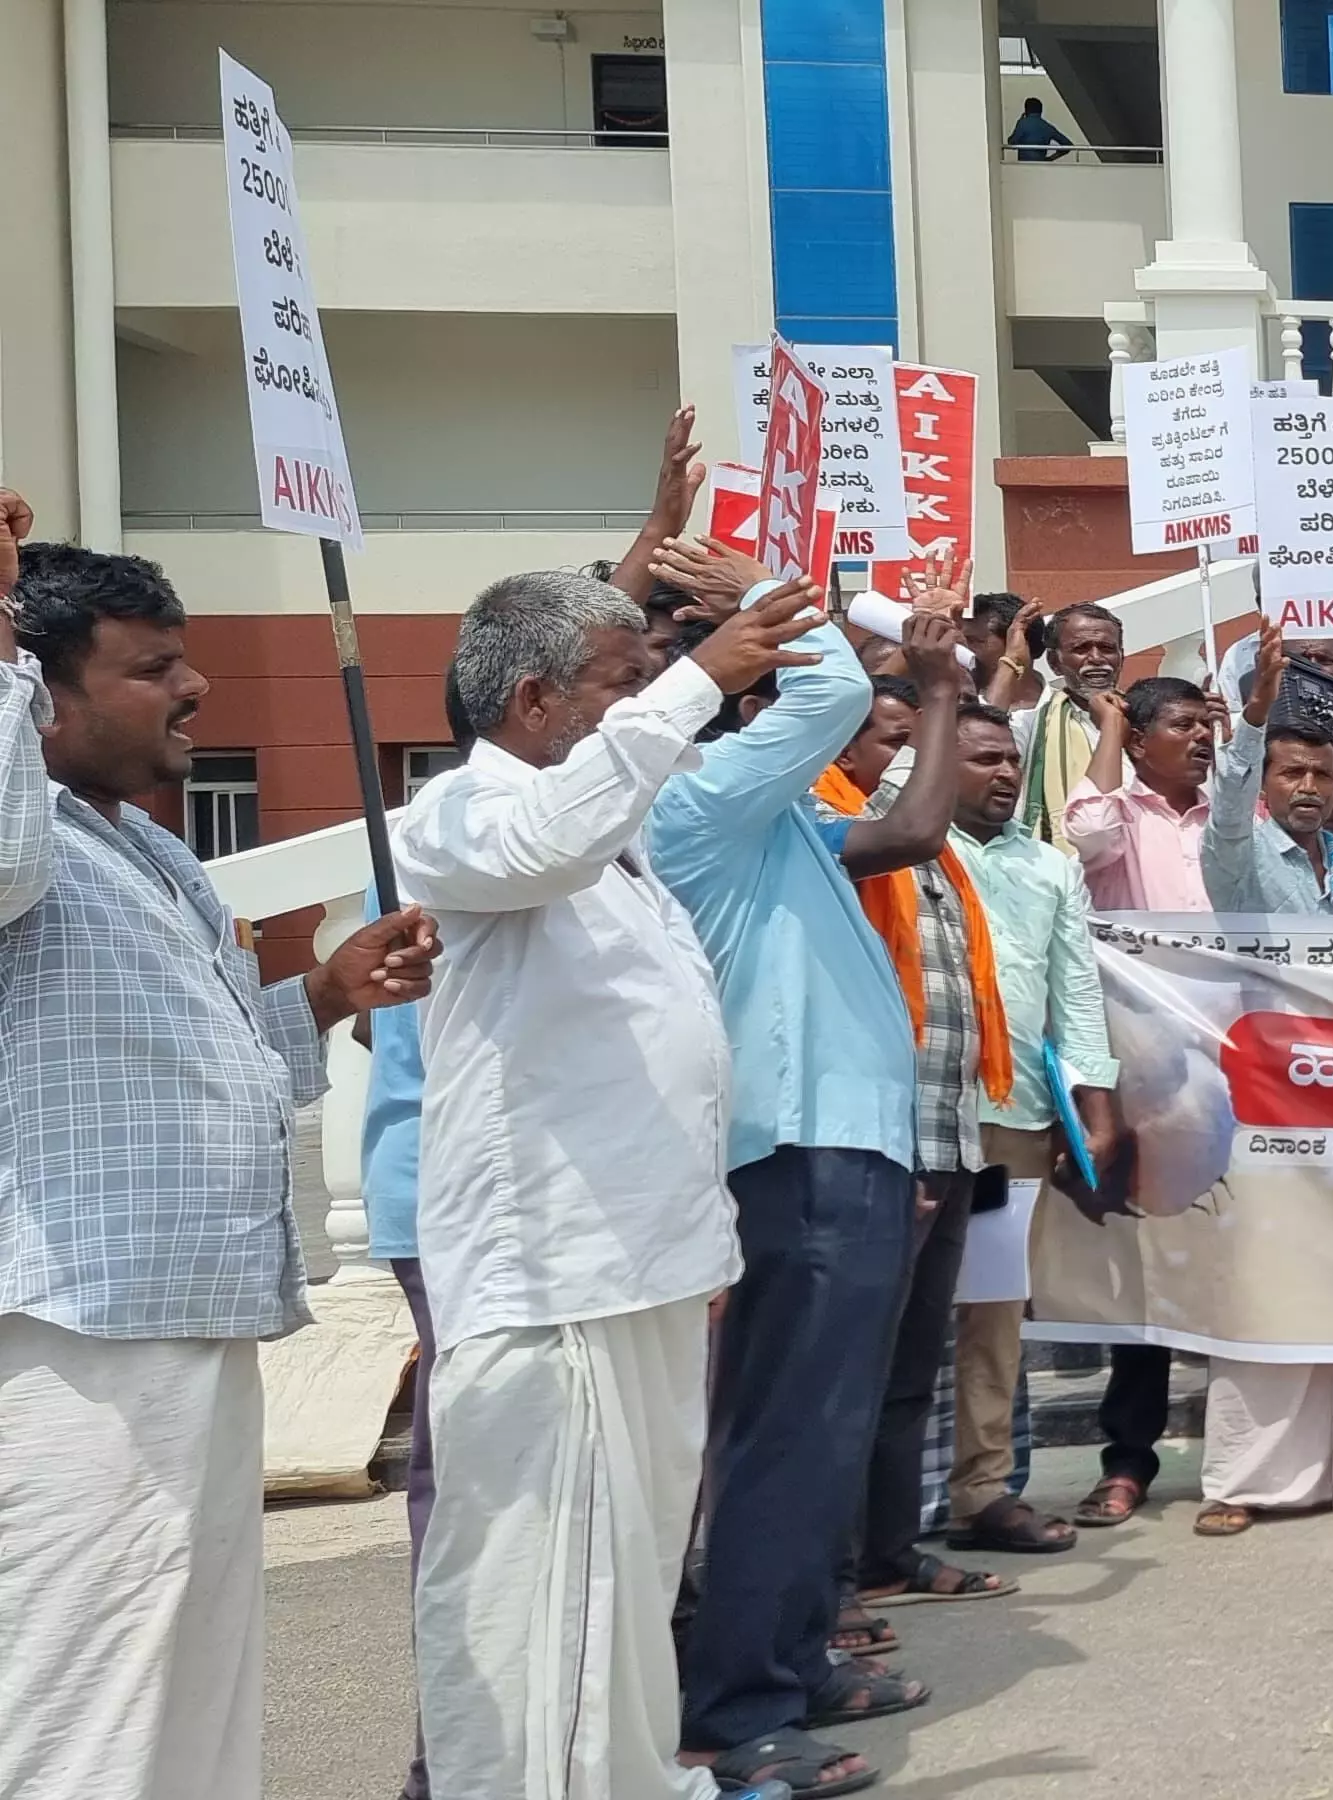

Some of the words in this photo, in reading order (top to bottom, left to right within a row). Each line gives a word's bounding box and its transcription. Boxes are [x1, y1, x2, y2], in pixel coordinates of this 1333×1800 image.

[1273, 412, 1326, 439] ಹತ್ತಿಗೆ
[1164, 514, 1232, 545] AIKKMS
[1248, 1134, 1327, 1158] ದಿನಾಂಕ
